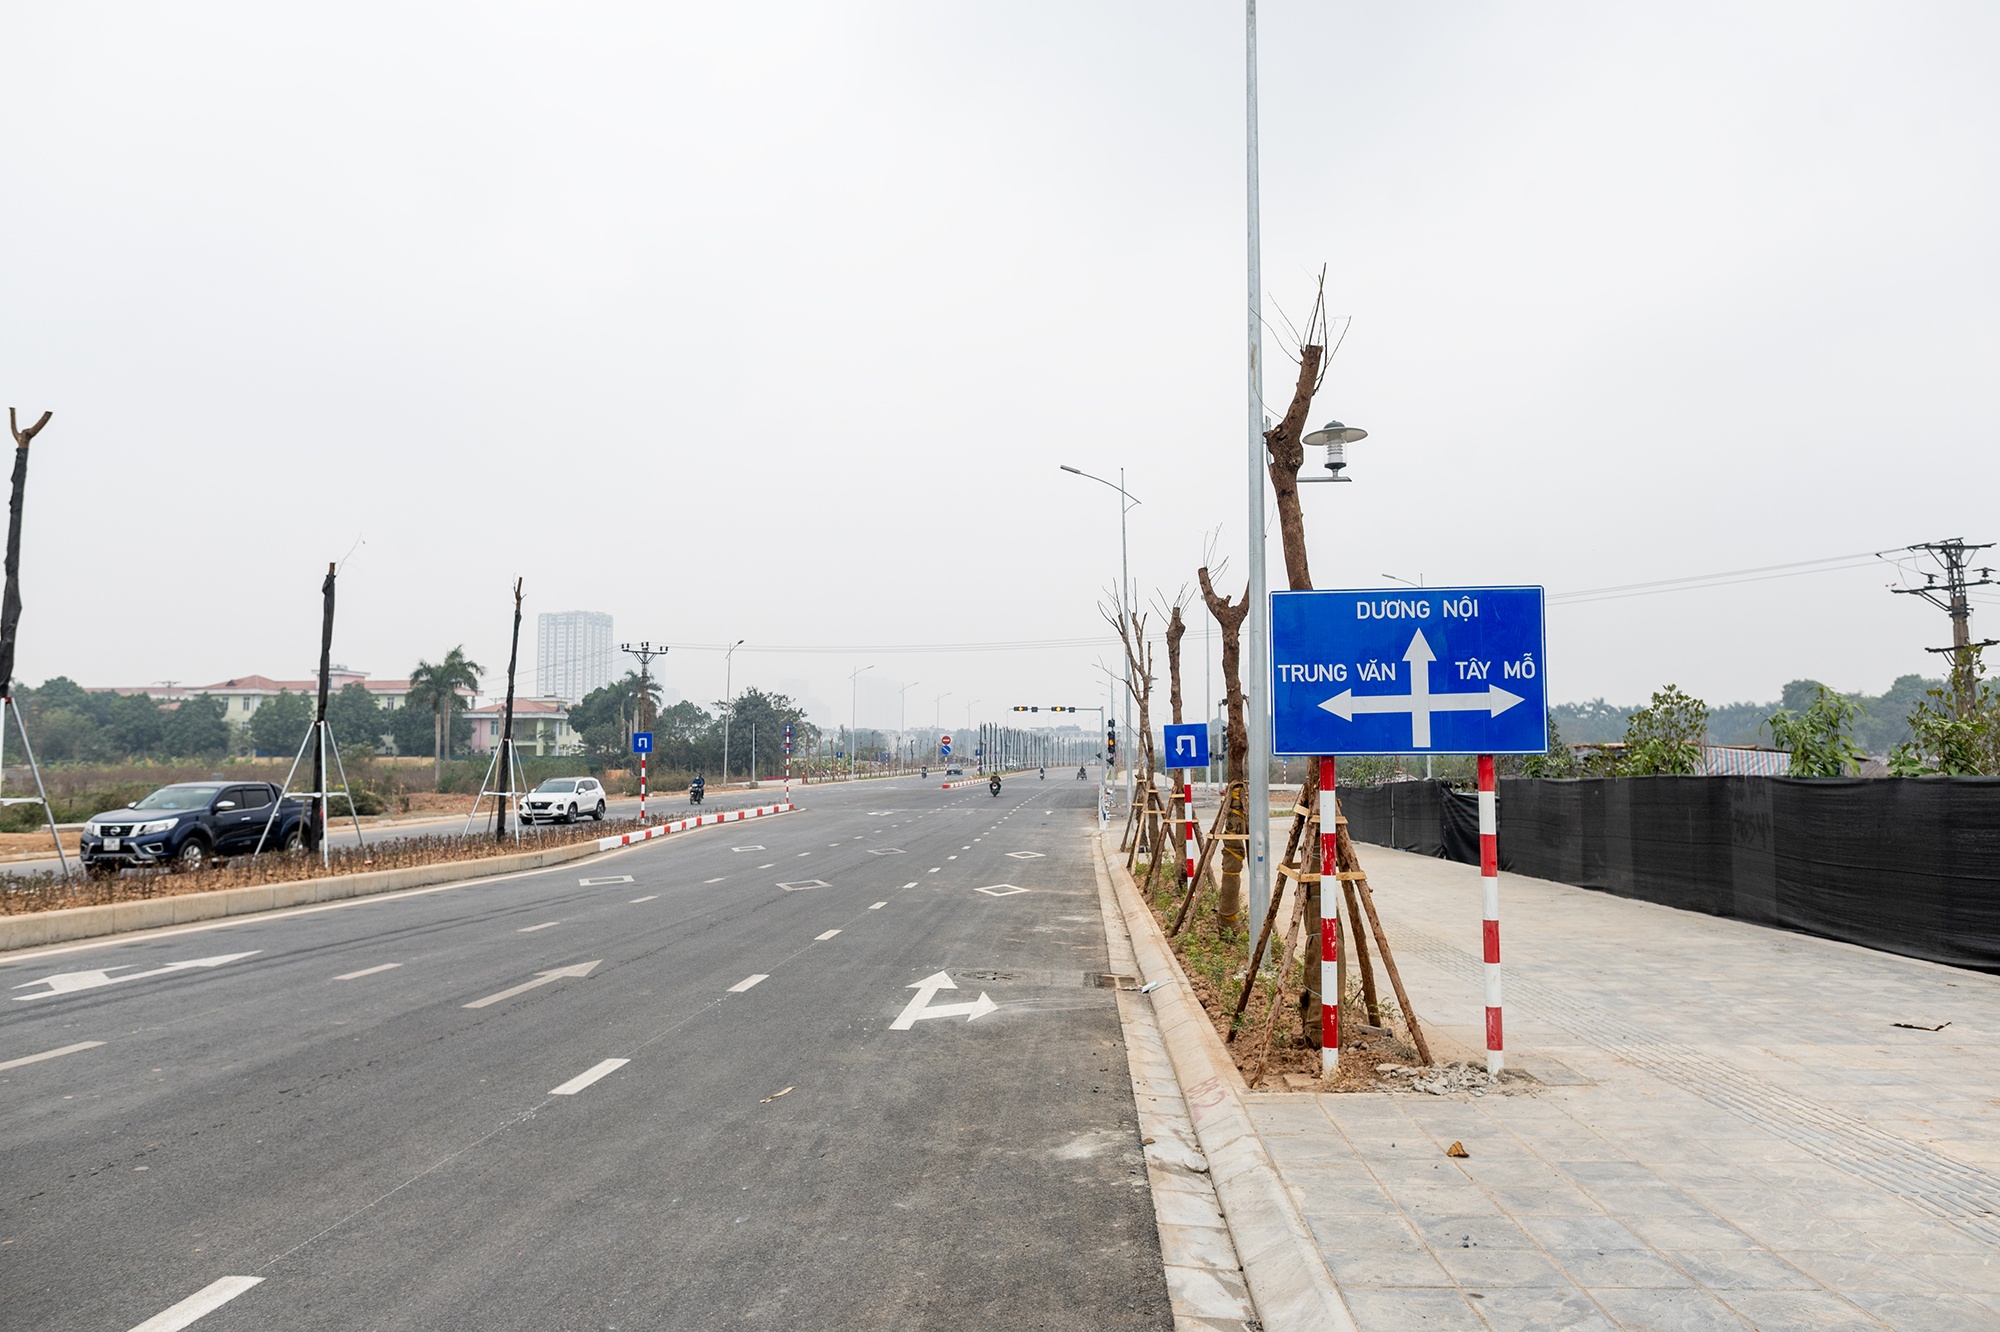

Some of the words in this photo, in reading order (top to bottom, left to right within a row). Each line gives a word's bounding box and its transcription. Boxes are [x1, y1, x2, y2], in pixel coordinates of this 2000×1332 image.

[1357, 600, 1430, 619] DƯƠNG
[1444, 596, 1478, 621] NỘI
[1278, 664, 1347, 682] TRUNG
[1357, 660, 1395, 681] VĂN
[1455, 658, 1491, 679] TÂY
[1504, 653, 1535, 678] MỖ
